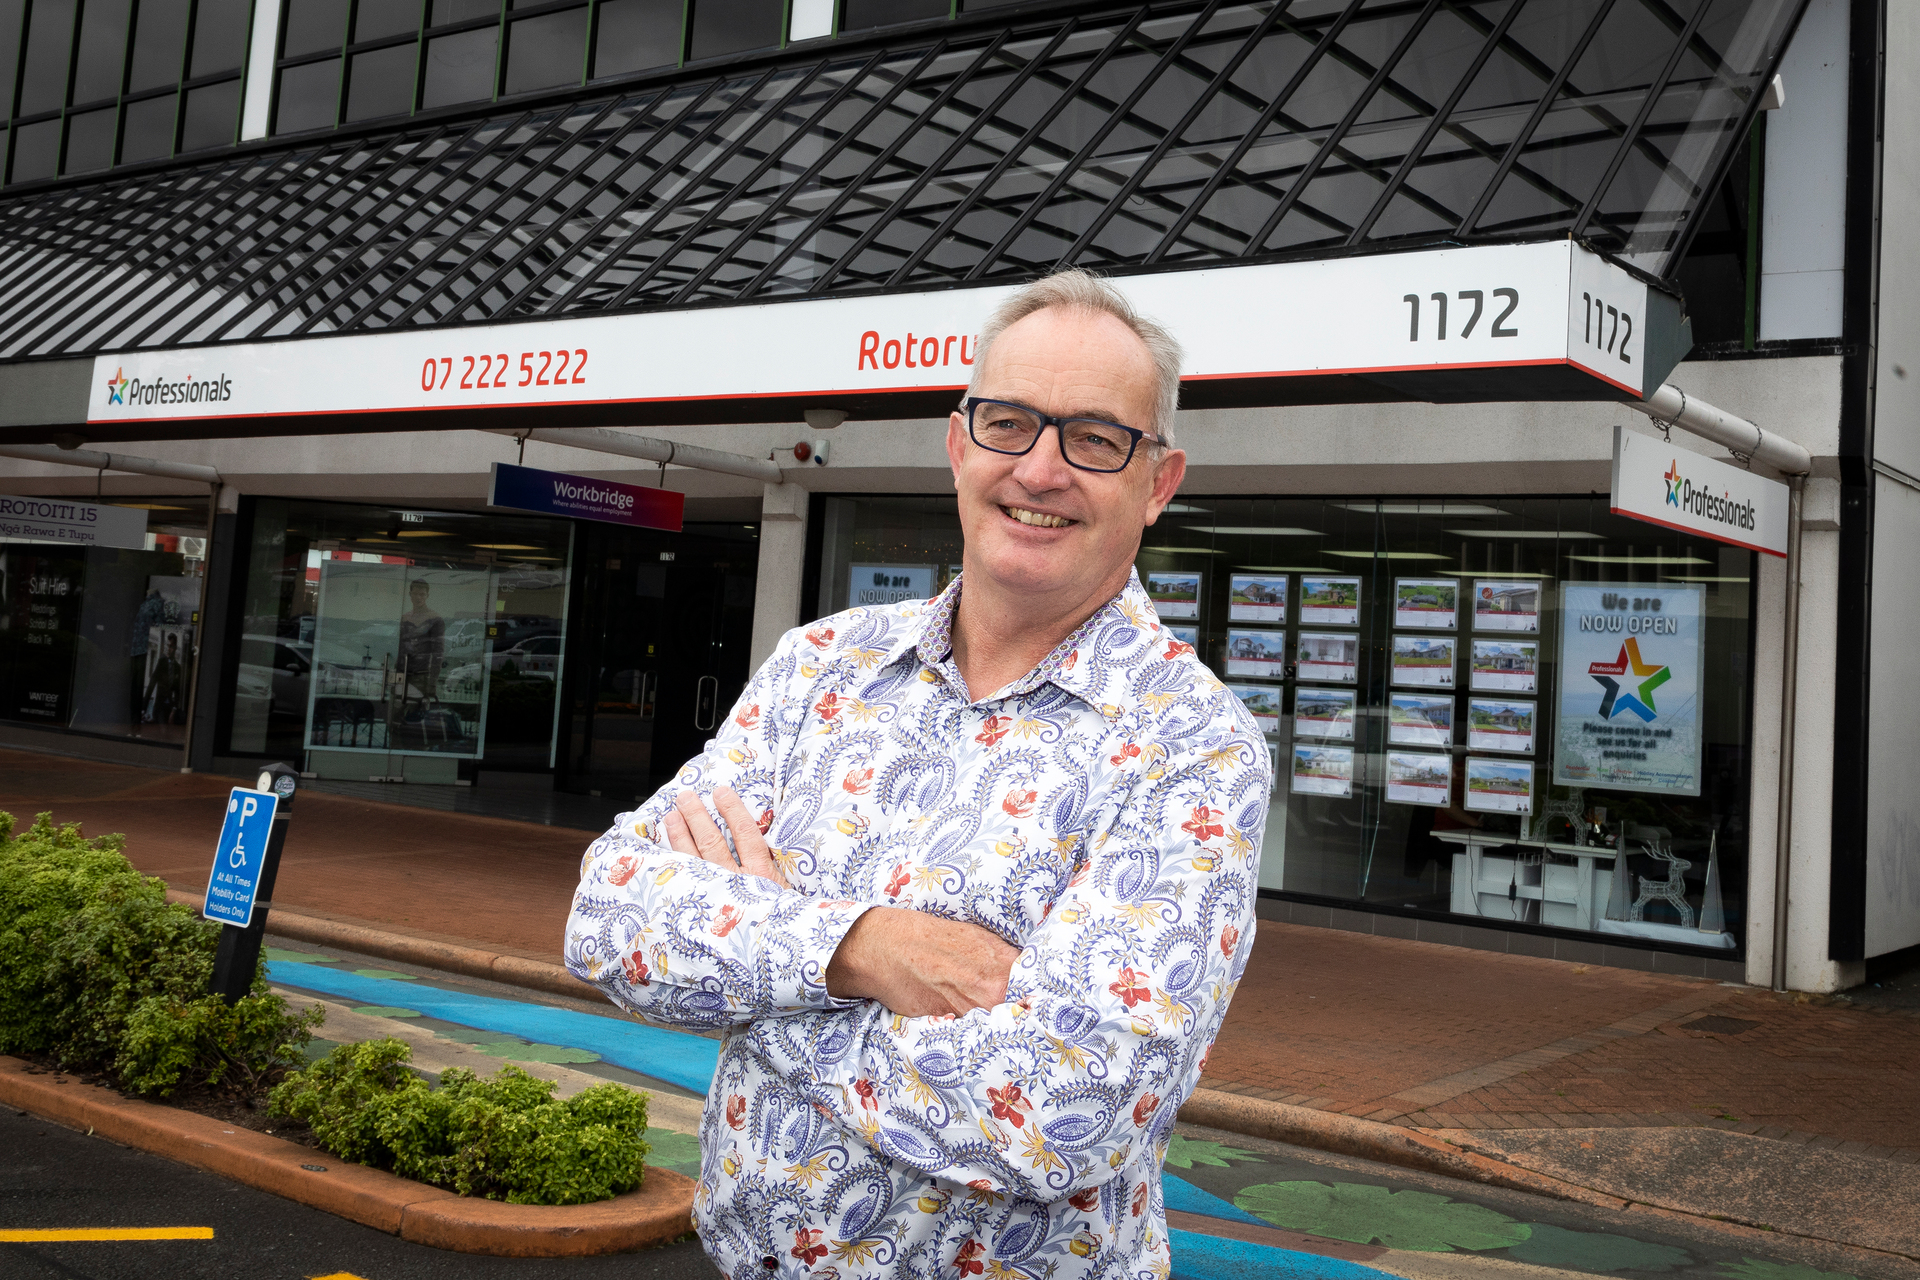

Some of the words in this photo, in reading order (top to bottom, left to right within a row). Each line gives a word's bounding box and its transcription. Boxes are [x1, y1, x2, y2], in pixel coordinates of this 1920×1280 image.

[1403, 287, 1519, 342] 1172
[1583, 291, 1632, 365] 1172
[421, 357, 452, 392] 07
[460, 354, 507, 390] 222
[518, 348, 589, 388] 5222
[129, 373, 232, 407] Professionals
[553, 481, 634, 508] Workbridge
[0, 499, 75, 520] ROTOITI
[79, 507, 98, 522] 15
[552, 498, 569, 508] Where
[569, 501, 588, 511] abilities
[589, 505, 602, 513] equal
[603, 507, 632, 517] employment
[1683, 478, 1755, 532] Professionals
[23, 525, 56, 538] Rawa
[58, 528, 66, 538] E
[68, 529, 95, 542] Tupu
[29, 577, 47, 594] Suit
[48, 577, 68, 596] Hire
[873, 573, 889, 587] We
[892, 575, 910, 587] are
[860, 590, 886, 604] NOW
[1602, 593, 1628, 611] We
[1633, 596, 1662, 612] are
[31, 603, 57, 617] Weddings
[28, 618, 47, 630] School
[1580, 615, 1622, 632] NOW
[1628, 617, 1677, 634] OPEN
[27, 633, 42, 644] Black
[43, 634, 53, 645] Tie
[1591, 665, 1623, 673] Professionals
[1583, 722, 1613, 736] Please
[1615, 726, 1640, 736] come
[1643, 727, 1651, 736] in
[1654, 728, 1672, 738] and
[1597, 737, 1612, 746] see
[1615, 738, 1626, 747] us
[1628, 738, 1641, 749] for
[1644, 739, 1656, 749] all
[1603, 749, 1646, 761] enquiries
[239, 797, 258, 827] P
[217, 872, 224, 882] At
[224, 873, 233, 884] All
[234, 874, 251, 888] Times
[211, 886, 234, 900] Mobility
[234, 891, 250, 903] Card
[208, 901, 231, 914] Holders
[231, 905, 246, 920] Only
